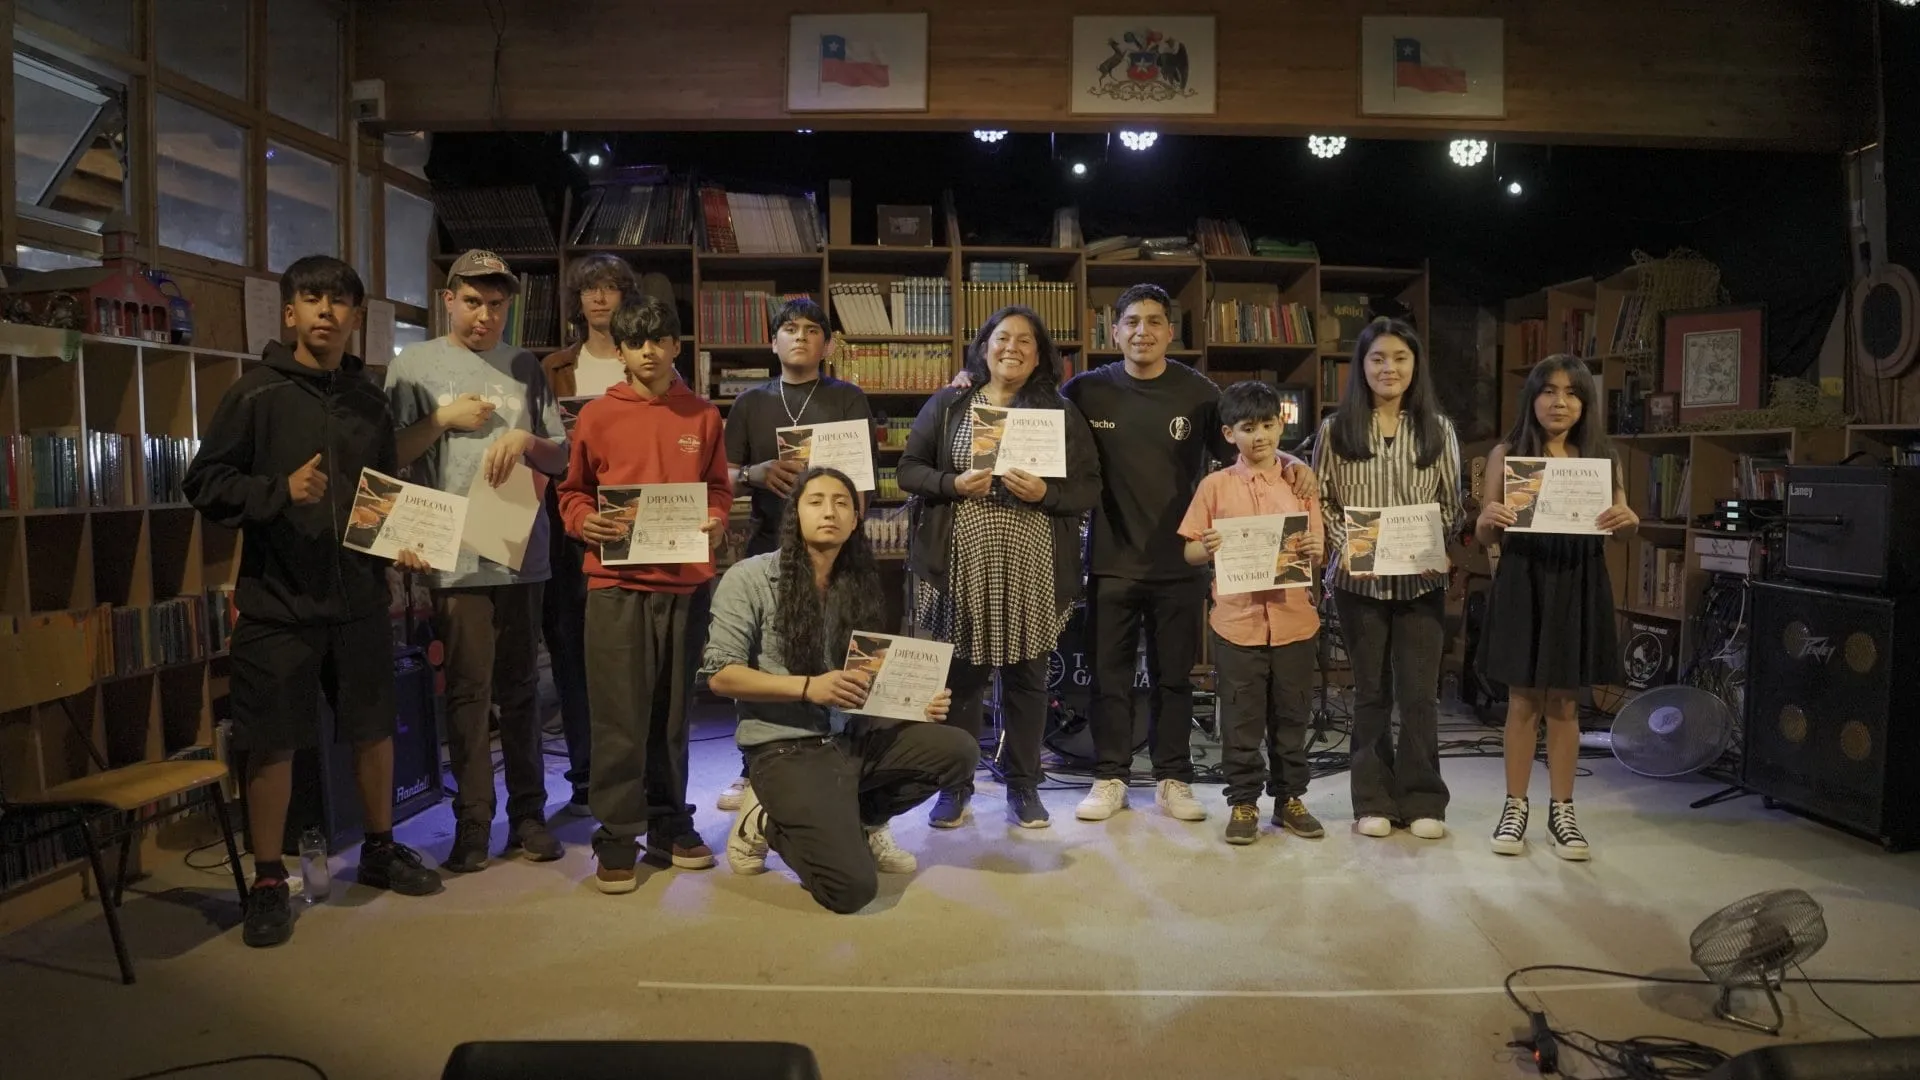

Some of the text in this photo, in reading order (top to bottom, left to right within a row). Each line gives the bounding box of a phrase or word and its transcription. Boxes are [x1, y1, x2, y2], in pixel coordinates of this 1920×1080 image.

[1012, 418, 1054, 428] DIPLOMA
[817, 431, 860, 443] DIPLOMA
[1551, 469, 1600, 478] DIPLOMA
[1789, 485, 1813, 498] Laney
[404, 494, 455, 514] DIPLOMA
[647, 495, 696, 505] DIPLOMA
[1386, 514, 1431, 525] DIPLOMA
[1226, 571, 1269, 583] DIPLOMA
[894, 648, 940, 664] DIPLOMA
[396, 774, 430, 803] Randall
